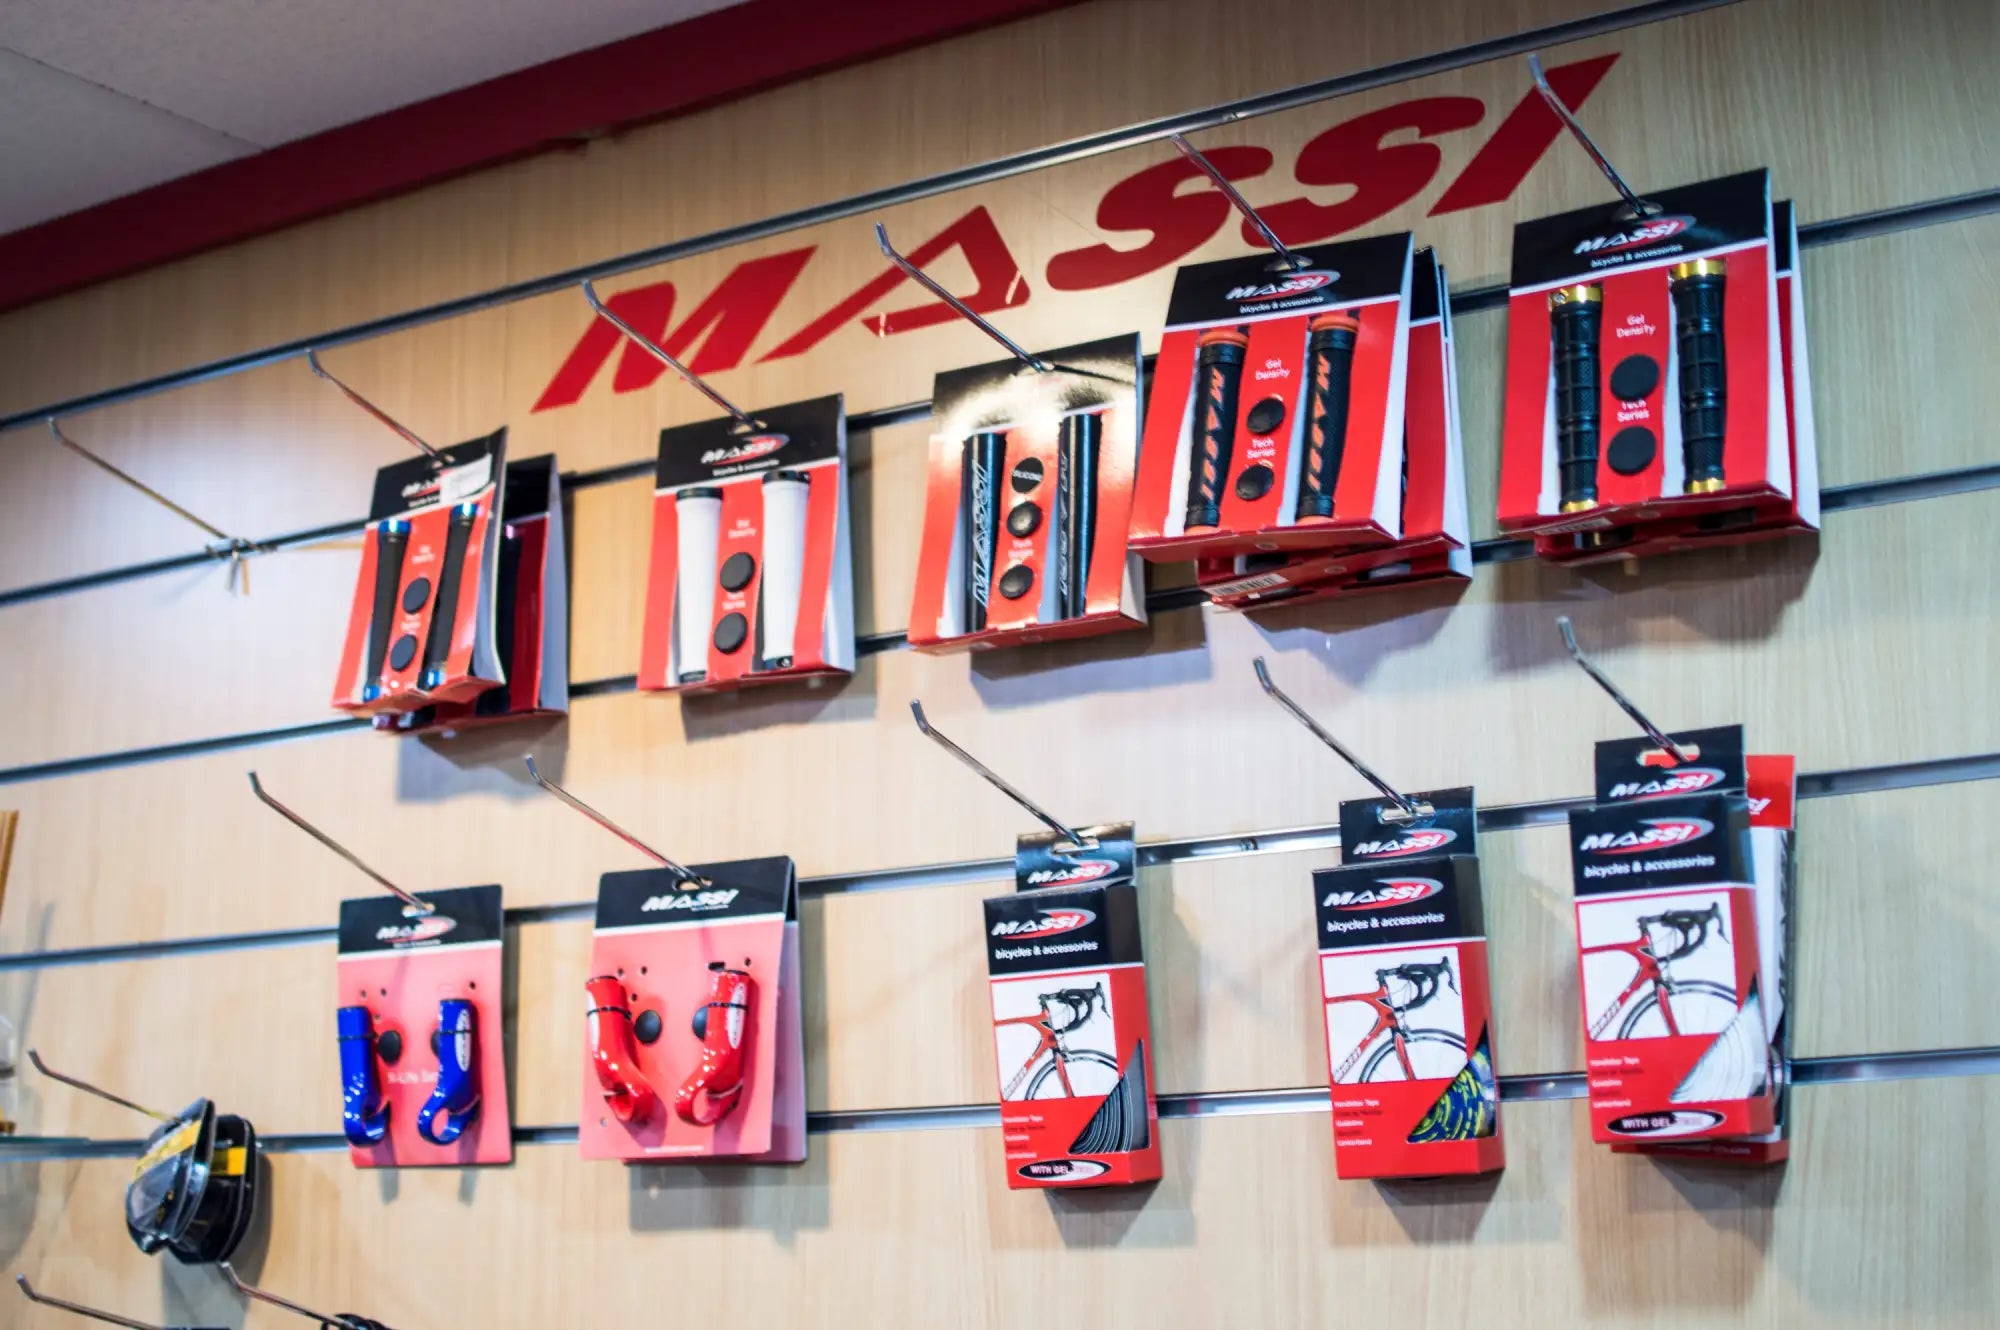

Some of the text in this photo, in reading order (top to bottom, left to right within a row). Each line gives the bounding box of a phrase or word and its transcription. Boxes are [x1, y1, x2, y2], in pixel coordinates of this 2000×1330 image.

[531, 53, 1621, 412] MASSI
[1573, 221, 1680, 254] MASSI
[1590, 254, 1624, 268] bicycles
[1634, 244, 1683, 259] accessories
[1225, 275, 1325, 300] MASSI
[1616, 323, 1656, 338] Density
[1626, 313, 1645, 325] Gel
[1201, 366, 1225, 500] MASSI
[1307, 352, 1331, 492] MASSI
[972, 459, 988, 609] MASSI
[1609, 774, 1710, 798] MASSI
[1353, 834, 1443, 855] MASSI
[1580, 825, 1695, 851] MASSI
[1026, 865, 1107, 884] MASSI
[1584, 854, 1716, 879] bicycles & accessories
[641, 888, 739, 912] MASSI
[1323, 885, 1426, 908] MASSI
[991, 914, 1081, 937] MASSI
[1327, 912, 1445, 933] bicycles & accessories
[995, 940, 1098, 961] bicycles & accessories
[1621, 1117, 1649, 1129] WITH
